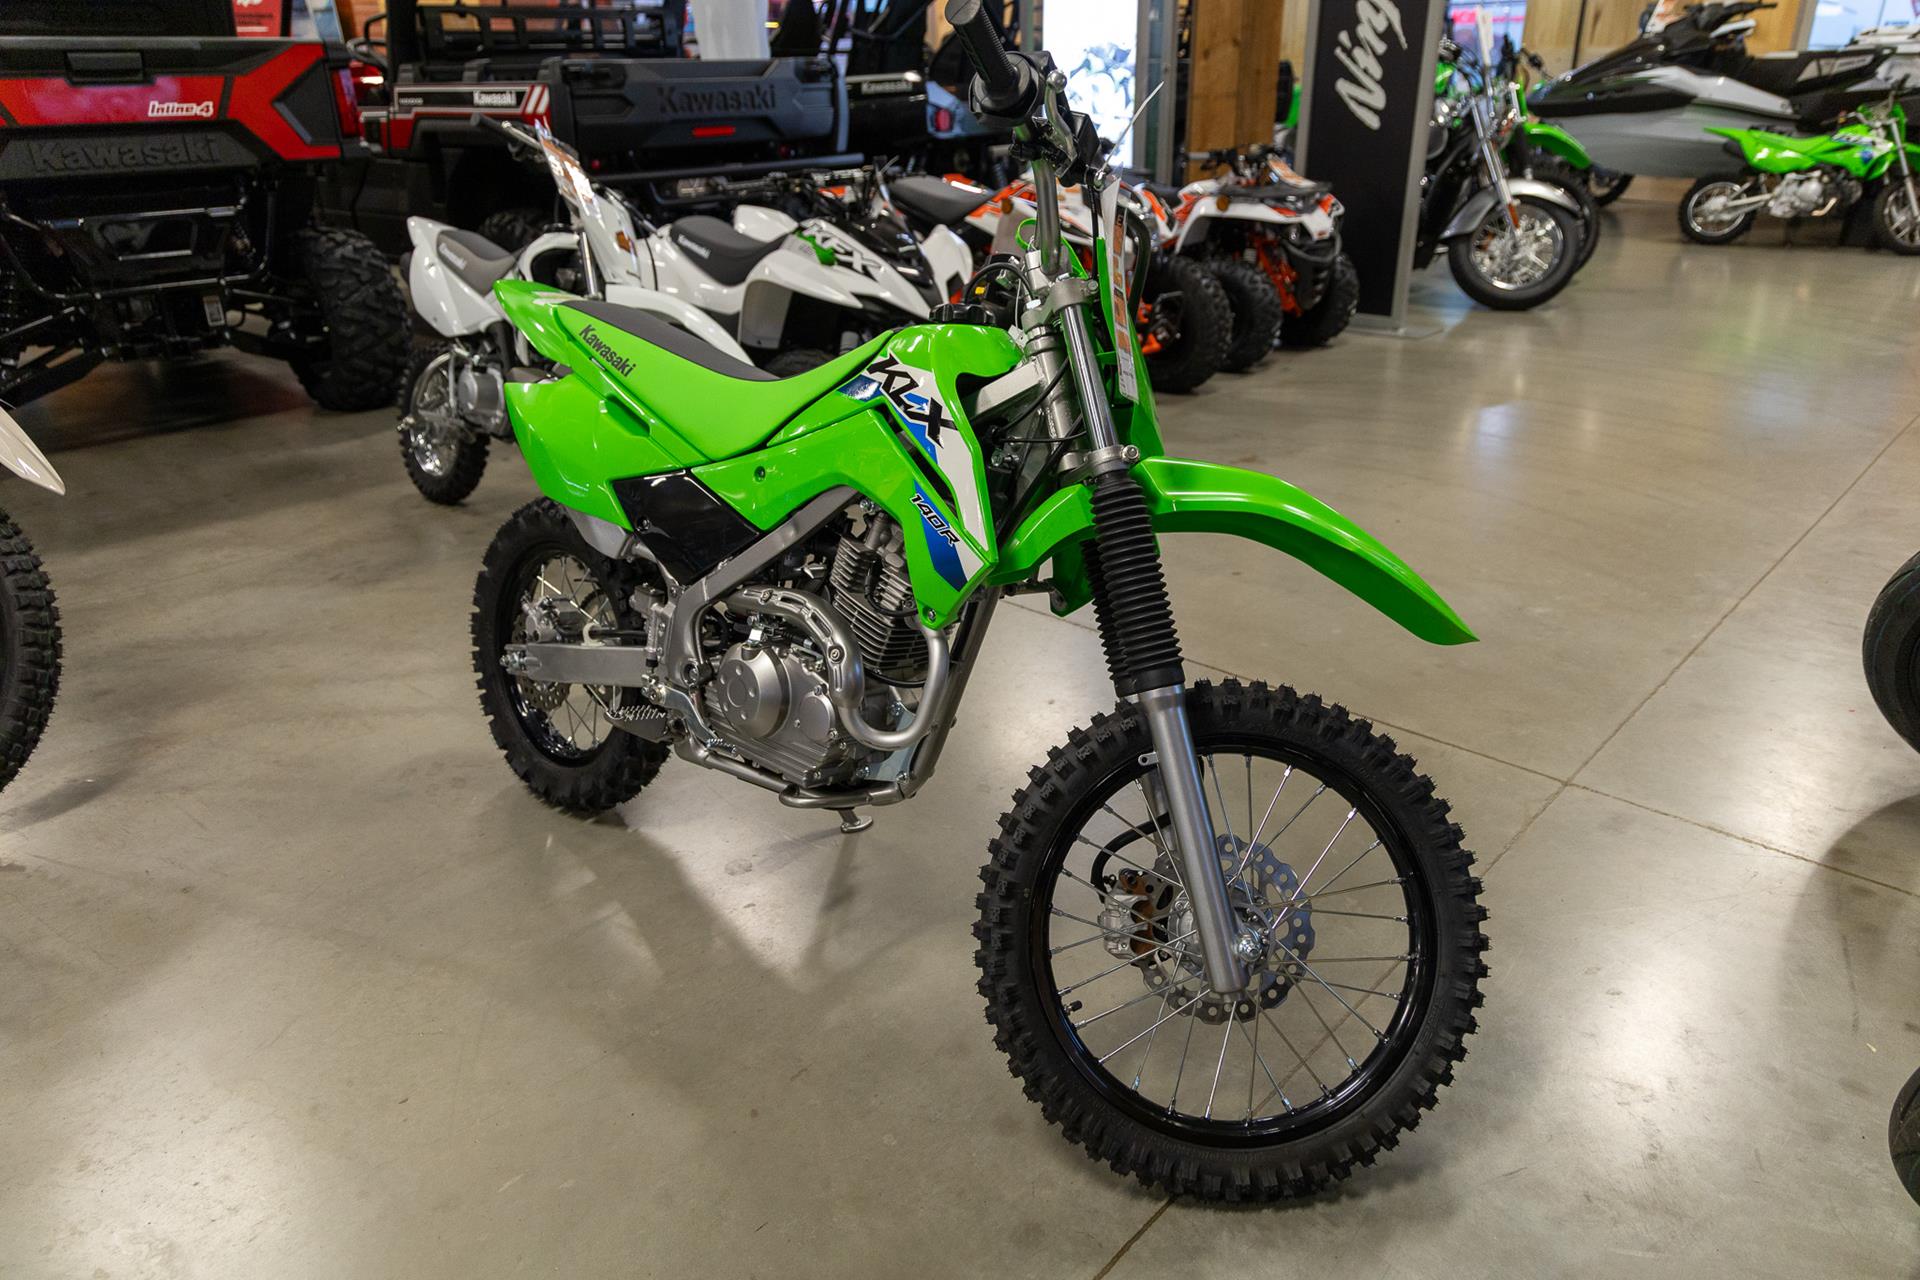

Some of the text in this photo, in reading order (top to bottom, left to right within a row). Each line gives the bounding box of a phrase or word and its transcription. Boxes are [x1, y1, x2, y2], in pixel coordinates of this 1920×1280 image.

[656, 83, 776, 113] Kawasaki
[30, 132, 220, 172] Kawasaki
[579, 324, 636, 377] Kawasaki
[865, 353, 959, 449] KLX
[910, 494, 960, 547] 140R
